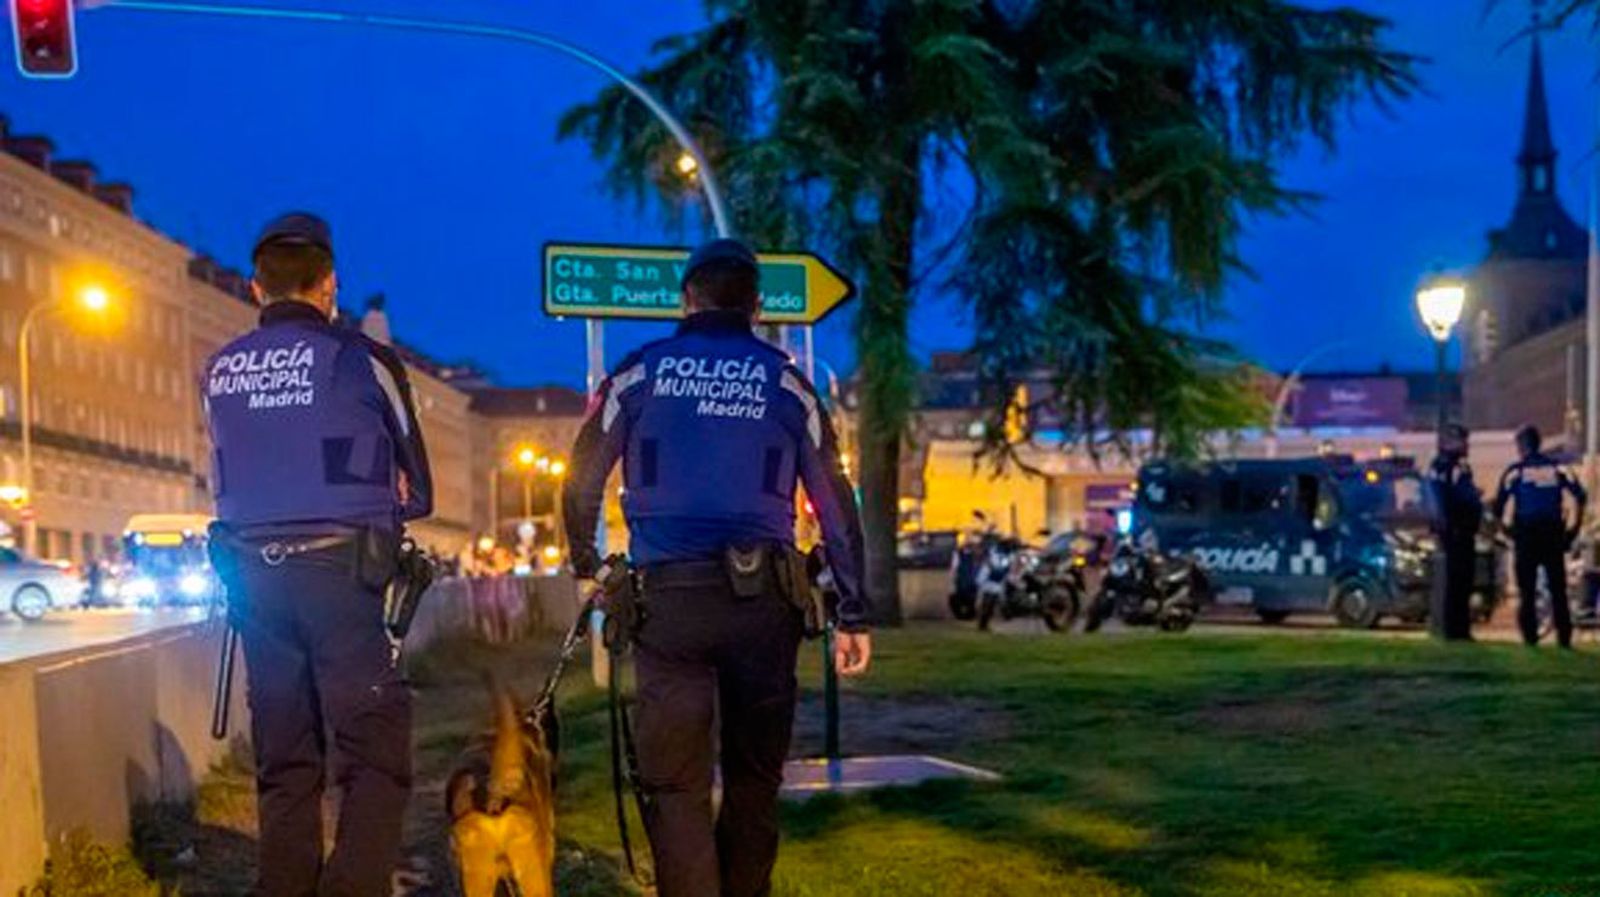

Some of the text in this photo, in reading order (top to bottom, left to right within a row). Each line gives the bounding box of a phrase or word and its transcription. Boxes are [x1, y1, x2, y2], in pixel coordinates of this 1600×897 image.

[615, 261, 660, 281] San
[555, 283, 600, 302] Gta.
[211, 341, 315, 376] POLICÍA
[655, 355, 769, 383] POLICÍA
[208, 367, 314, 398] MUNICIPAL
[652, 377, 767, 403] MUNICIPAL
[248, 389, 314, 408] Madrid
[696, 400, 767, 420] Madrid
